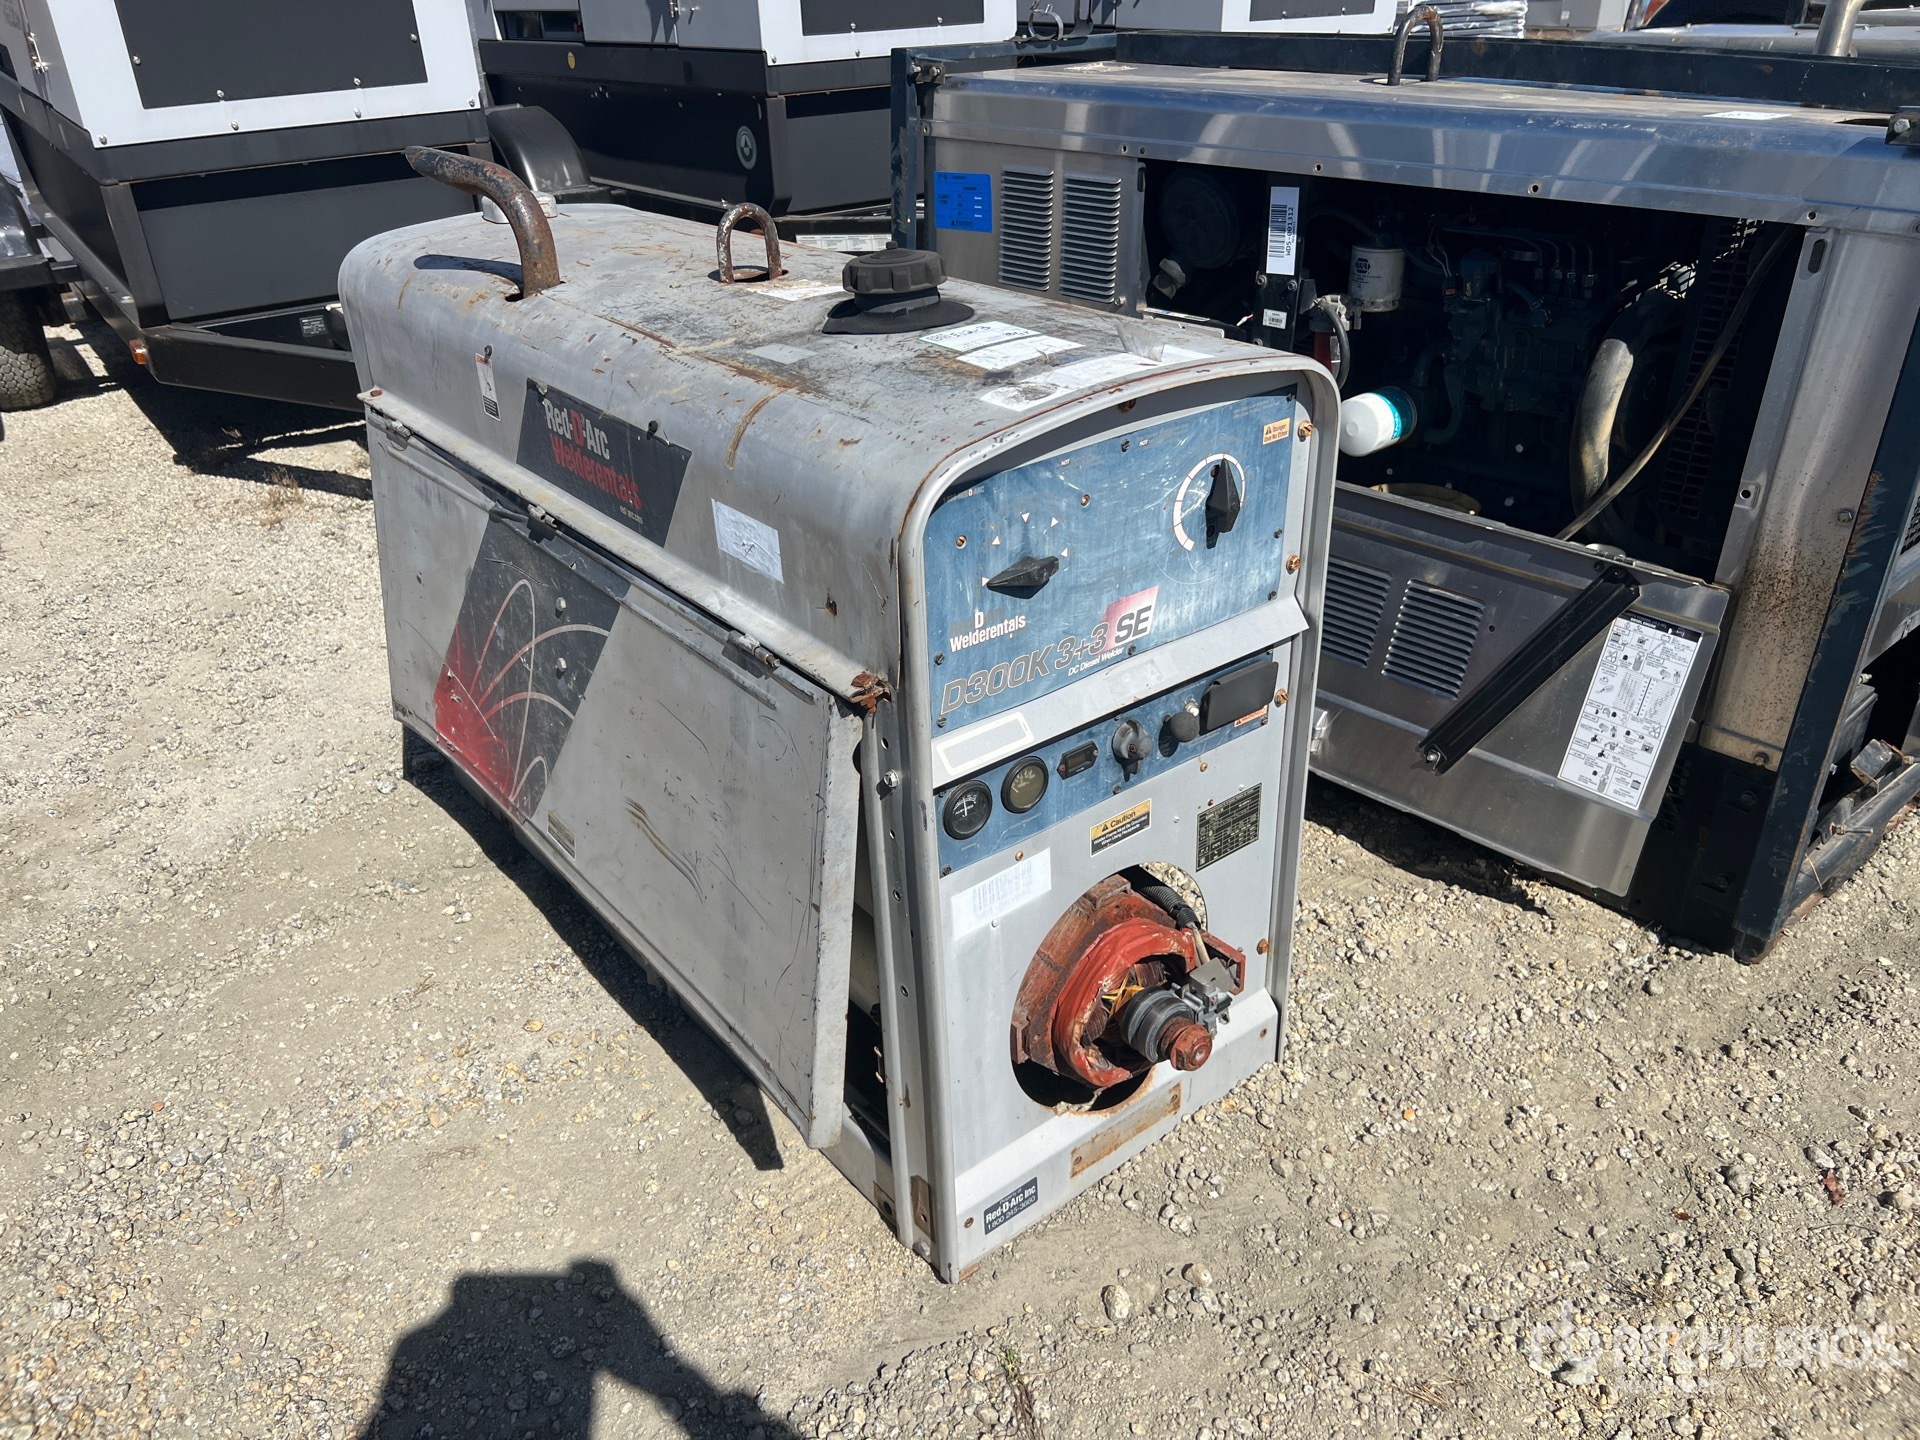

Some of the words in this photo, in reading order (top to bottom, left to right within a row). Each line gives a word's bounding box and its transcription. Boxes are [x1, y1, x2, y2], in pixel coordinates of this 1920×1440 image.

[550, 433, 642, 510] Welderentals
[950, 615, 1026, 652] Welderentals
[941, 644, 1054, 714] D300K
[1115, 605, 1152, 644] SE
[1068, 666, 1080, 676] DC
[1080, 656, 1100, 670] Diesel
[1101, 647, 1125, 662] Welder
[1111, 812, 1135, 827] Caution
[986, 1194, 1024, 1224] Red-D-Arc
[1024, 1186, 1036, 1198] Inc
[992, 1216, 1004, 1228] 800
